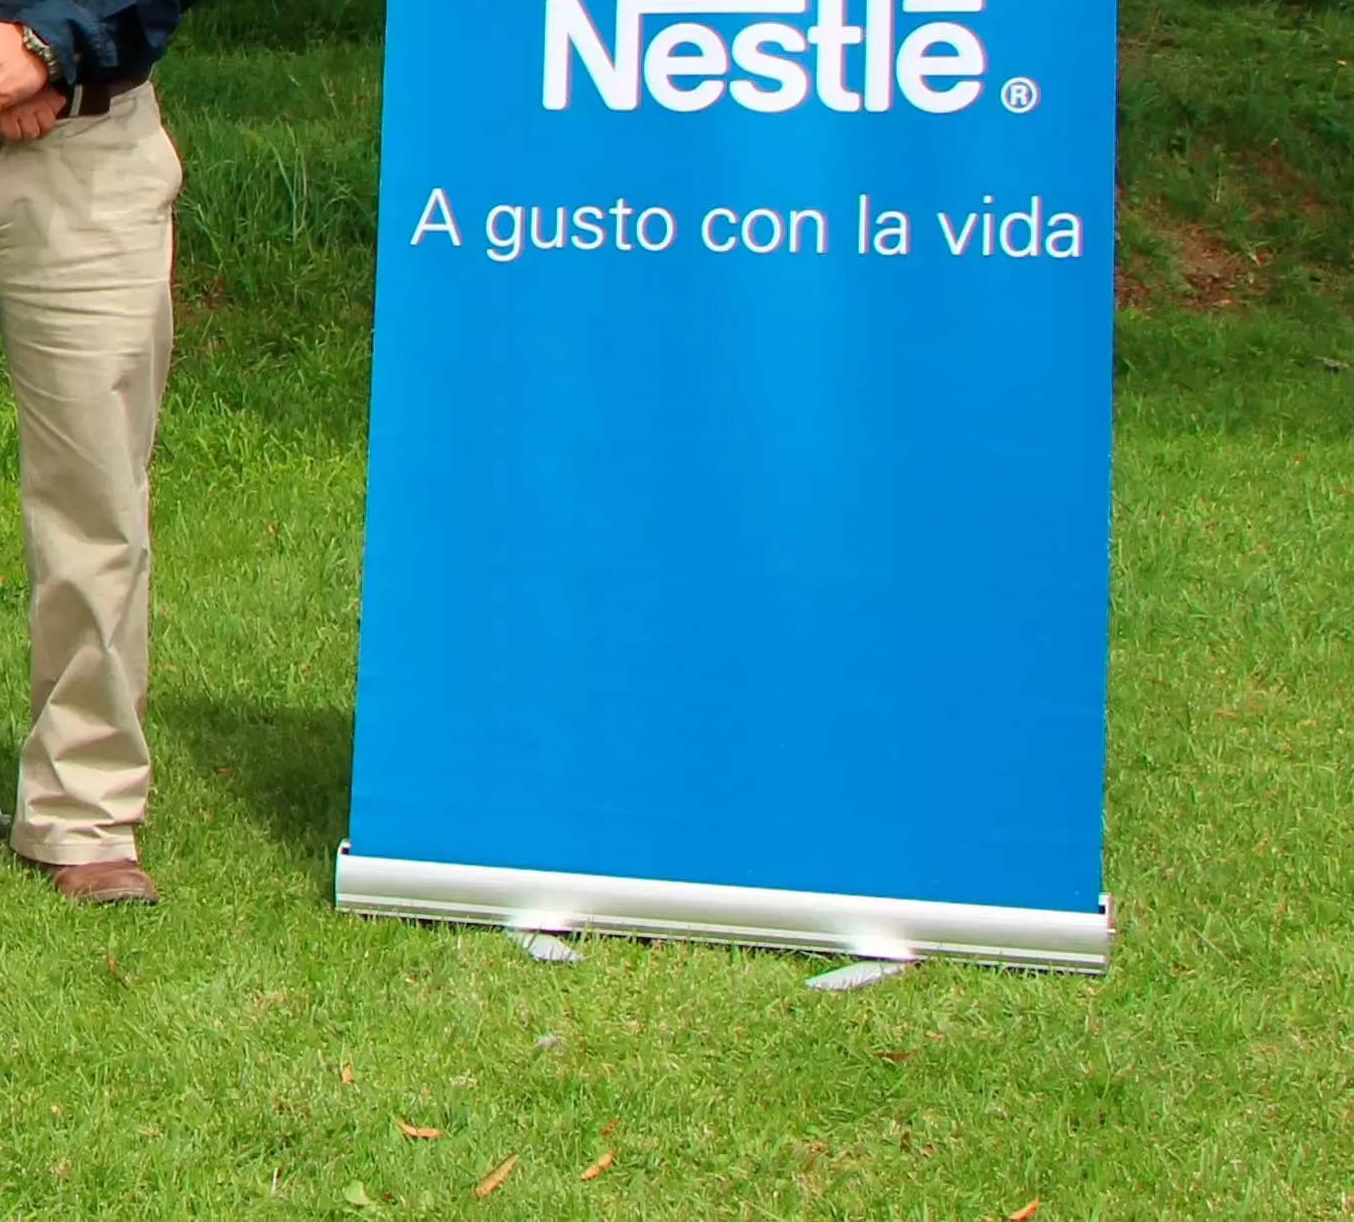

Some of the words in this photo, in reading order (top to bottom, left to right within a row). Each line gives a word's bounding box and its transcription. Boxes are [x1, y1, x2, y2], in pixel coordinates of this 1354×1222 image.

[410, 188, 461, 247] A
[486, 198, 677, 262] gusto
[702, 206, 828, 254] con
[858, 194, 910, 256] la
[937, 195, 1084, 259] vida
